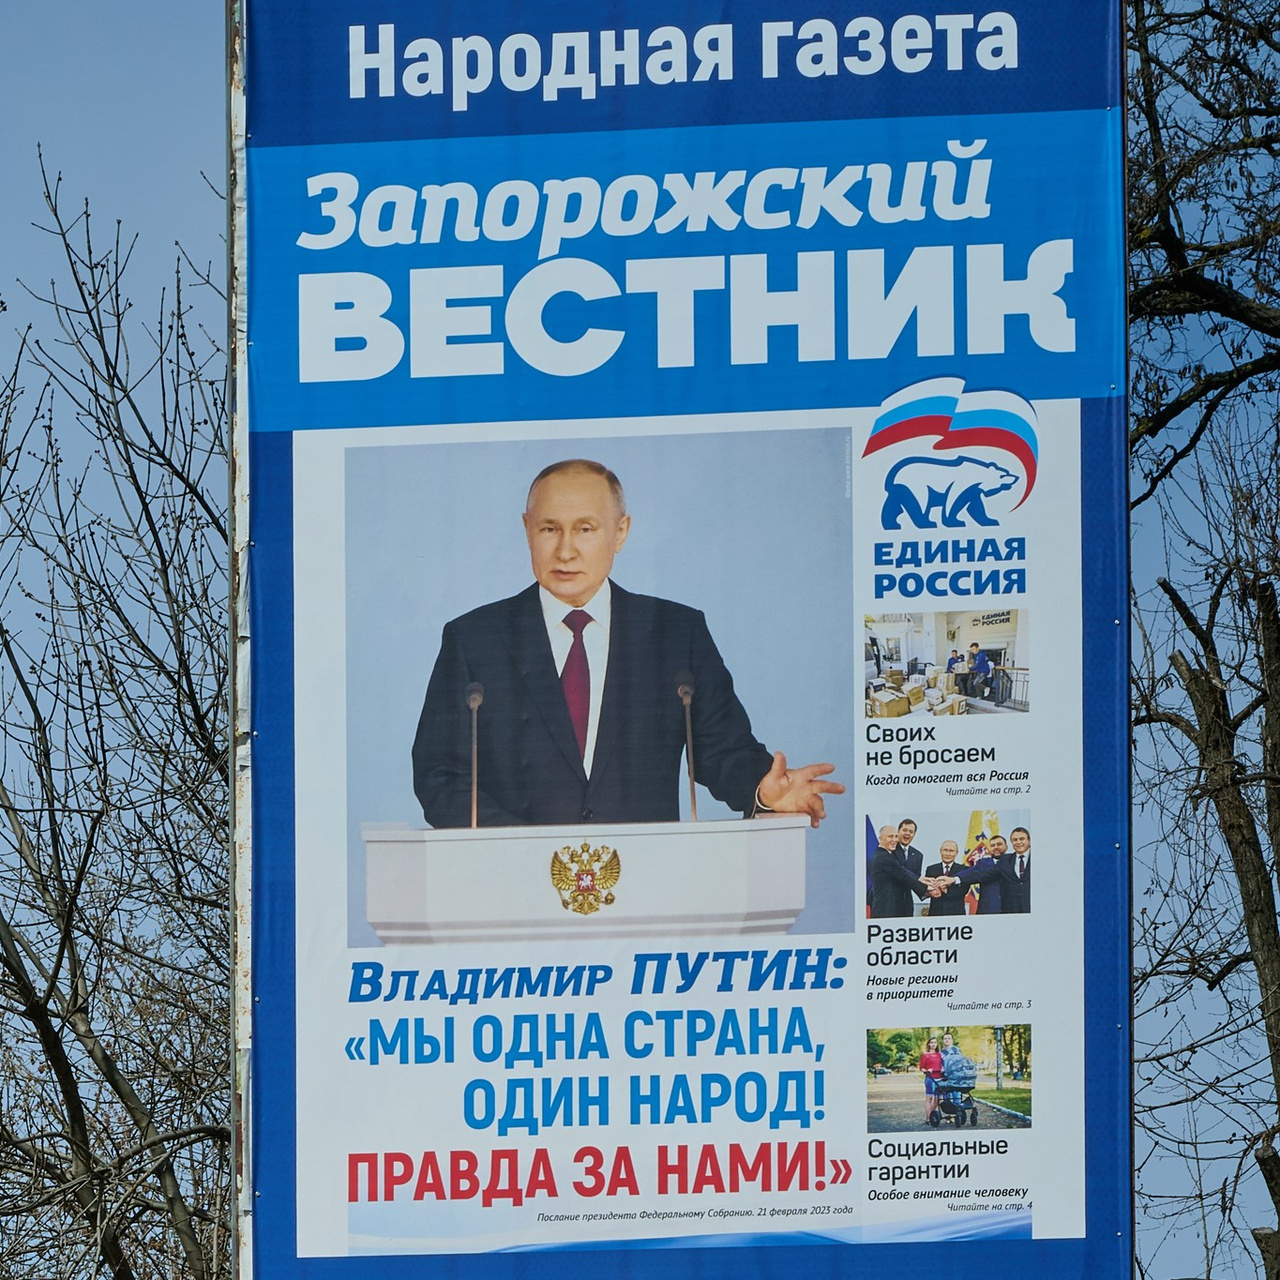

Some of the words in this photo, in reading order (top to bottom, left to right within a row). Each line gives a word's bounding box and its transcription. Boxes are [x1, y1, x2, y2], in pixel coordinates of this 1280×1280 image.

[348, 23, 733, 111] Народная
[762, 10, 1019, 79] газета
[296, 139, 993, 260] Запорожский
[298, 239, 1075, 383] ВЕСТНИК
[874, 537, 1025, 568] ЕДИНАЯ
[874, 568, 1026, 599] РОССИЯ
[981, 617, 1011, 626] РОССИЯ
[866, 723, 935, 743] Своих
[866, 749, 892, 765] не
[899, 745, 995, 769] бросаем
[865, 774, 900, 786] Когда
[903, 774, 963, 785] помогает
[966, 773, 986, 782] вся
[989, 770, 1029, 781] Россия
[945, 787, 988, 796] Читайте
[1003, 786, 1023, 796] стр.
[1025, 785, 1031, 793] 2
[866, 924, 973, 944] Развитие
[866, 946, 958, 966] области
[631, 948, 847, 994] ПУТИН:
[866, 974, 905, 987] Новые
[908, 975, 958, 988] регионы
[866, 992, 873, 1000] в
[877, 988, 954, 1002] приоритете
[946, 1001, 989, 1011] Читайте
[1004, 1001, 1024, 1011] стр.
[1027, 999, 1032, 1008] 3
[345, 1017, 455, 1065] «МЫ
[472, 1012, 609, 1069] ОДНА
[623, 1006, 826, 1063] СТРАНА,
[463, 1075, 609, 1136] ОДИН
[628, 1069, 826, 1130] НАРОД!
[867, 1138, 1008, 1160] Социальные
[348, 1148, 558, 1208] ПРАВДА
[572, 1146, 639, 1197] ЗА
[657, 1140, 853, 1194] НАМИ!»
[868, 1162, 970, 1185] гарантии
[867, 1188, 909, 1201] Особое
[913, 1189, 971, 1199] внимание
[974, 1187, 1029, 1199] человеку
[537, 1212, 580, 1222] Послание
[582, 1211, 637, 1222] президента
[639, 1209, 706, 1220] Федеральному
[708, 1207, 754, 1218] Собранию.
[757, 1207, 767, 1217] 21
[769, 1206, 808, 1217] февраля
[810, 1205, 831, 1215] 2023
[832, 1204, 854, 1215] года
[947, 1203, 989, 1212] Читайте
[1005, 1203, 1024, 1212] стр.
[1026, 1201, 1033, 1209] 4
